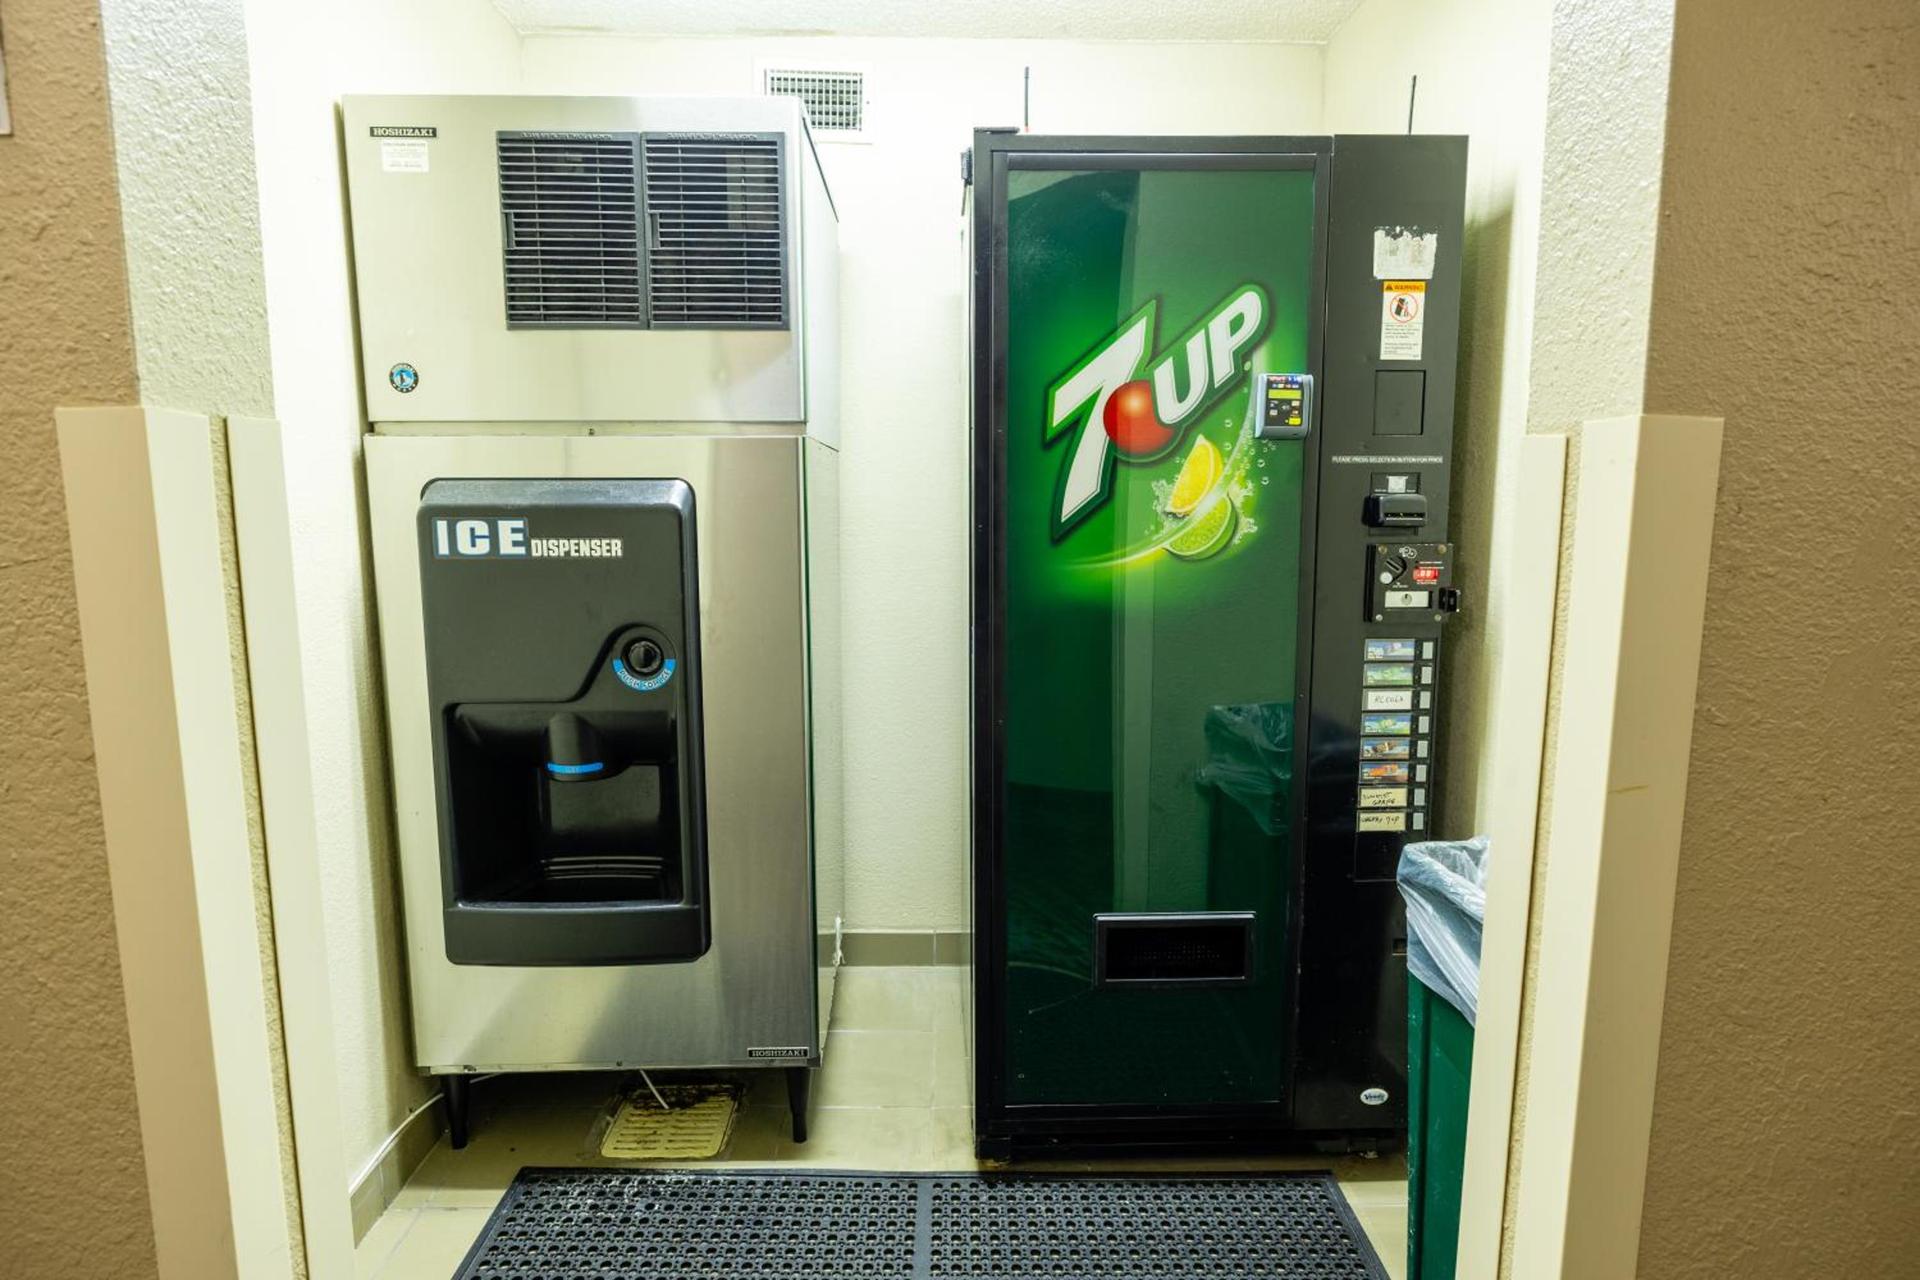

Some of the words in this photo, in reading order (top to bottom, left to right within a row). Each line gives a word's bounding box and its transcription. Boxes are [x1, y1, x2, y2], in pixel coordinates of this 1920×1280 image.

[373, 127, 434, 137] HOSHIZAKI
[1332, 455, 1351, 464] PLEASE
[436, 519, 527, 556] ICE
[531, 538, 622, 557] DISPENSER
